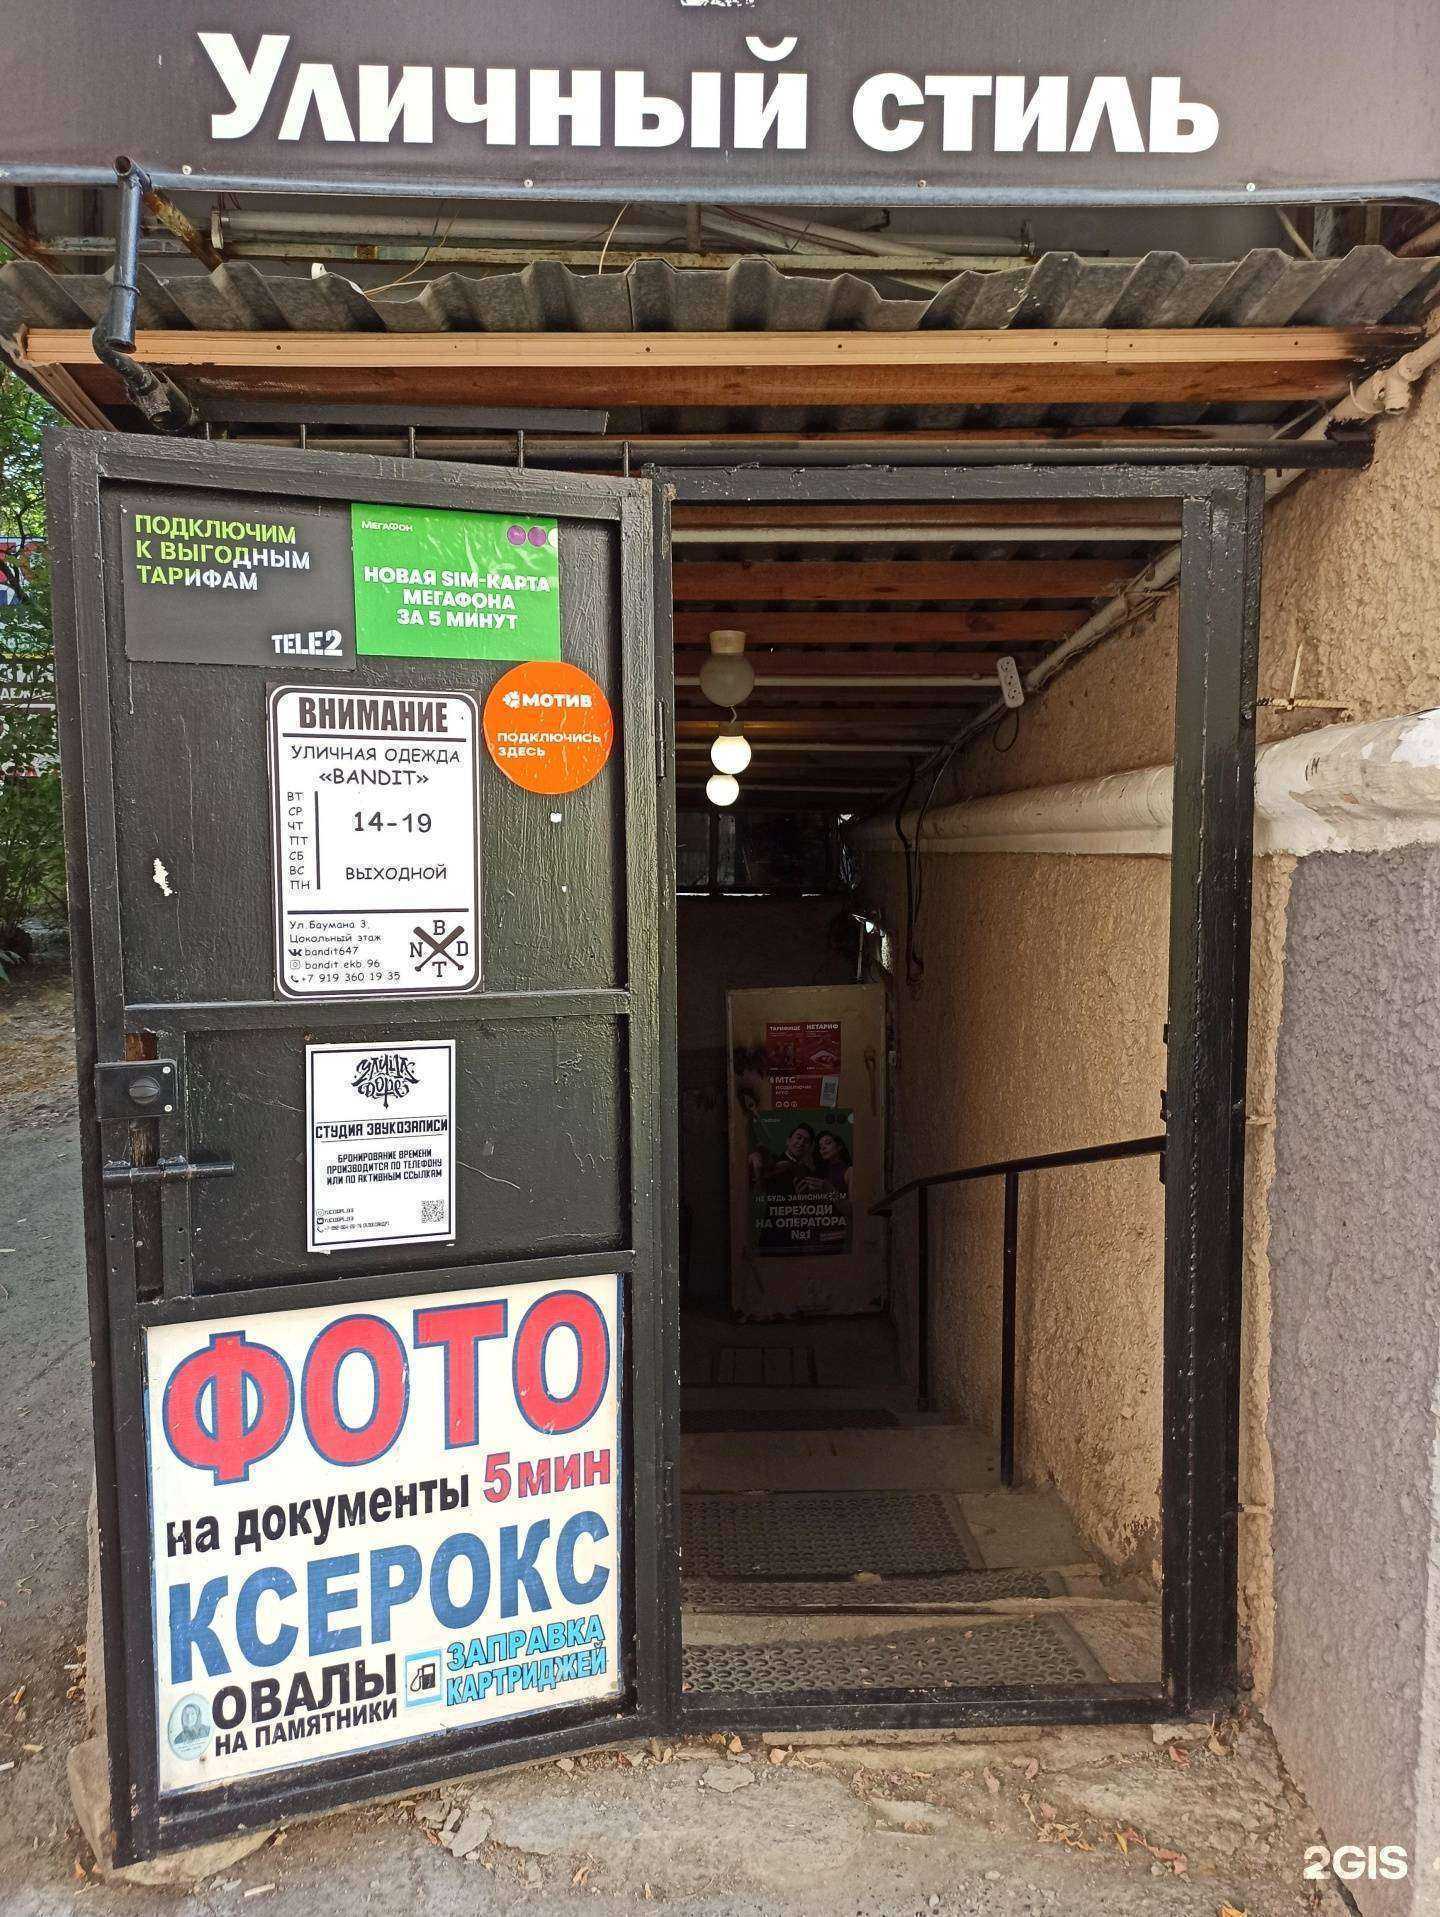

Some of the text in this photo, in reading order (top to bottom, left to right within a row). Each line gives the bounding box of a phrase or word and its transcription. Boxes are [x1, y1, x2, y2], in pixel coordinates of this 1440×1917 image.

[196, 32, 1220, 154] Уличный стиль
[136, 514, 296, 544] ПОДКЛЮЧИМ
[136, 540, 311, 570] К ВЫГОДНЫМ
[136, 565, 259, 590] ТАРИФАМ
[364, 566, 552, 592] НОВАЯ SIM-КАРТА
[403, 589, 516, 610] МЕГАФОНА
[396, 608, 518, 630] ЗА 5 МИНУТ
[271, 630, 343, 657] TELE2
[522, 692, 593, 708] МОТИВ
[298, 696, 449, 733] ВНИМАНИЕ
[496, 731, 601, 743] ПОДКЛЮЧИСЬ
[291, 745, 461, 764] УЛИЧНАЯ ОДЕЖДА
[498, 745, 545, 758] ЗДЕСЬ
[319, 768, 429, 785] «BANDIT»
[287, 791, 304, 801] ВТ
[288, 806, 303, 816] СР
[288, 821, 304, 830] ЧТ
[353, 811, 432, 833] 14-19
[289, 836, 308, 846] ПТ
[289, 851, 304, 861] СБ
[289, 866, 304, 875] ВС
[345, 864, 447, 881] ВЫХОДНОЙ
[290, 880, 310, 890] ПН
[309, 920, 355, 931] Баумана
[433, 919, 445, 936] B
[289, 932, 382, 944] Цокольный этаж
[410, 940, 469, 958] N D
[319, 973, 339, 982] 919
[344, 973, 365, 982] 360
[369, 972, 383, 981] 19
[388, 971, 401, 981] 35
[432, 961, 447, 978] T
[315, 1119, 448, 1139] СТУДИЯ ЗВУКОЗАПИСИ
[338, 1148, 432, 1163] БРОНИРОВАНИЕ ВРЕМЕНИ
[326, 1158, 442, 1175] ПРОИЗВОДИТСЯ ПО ТЕЛЕФОНУ
[326, 1169, 442, 1186] ИЛИ ПО АКТИВНЫМ ССЫЛКАМ
[769, 1204, 833, 1216] ПЕРЕХОДИ
[755, 1216, 848, 1228] НА ОПЕРАТОРА
[162, 1289, 612, 1487] ФОТО
[166, 1514, 221, 1557] на
[234, 1474, 470, 1556] документы
[482, 1452, 512, 1504] 5
[169, 1510, 610, 1686] КСЕРОКС
[446, 1614, 606, 1672] ЗАПРАВКА
[446, 1643, 607, 1707] КАРТРИДЖЕЙ
[211, 1653, 398, 1730] ОВАЛЫ
[215, 1697, 398, 1757] НА ПАМЯТНИКИ
